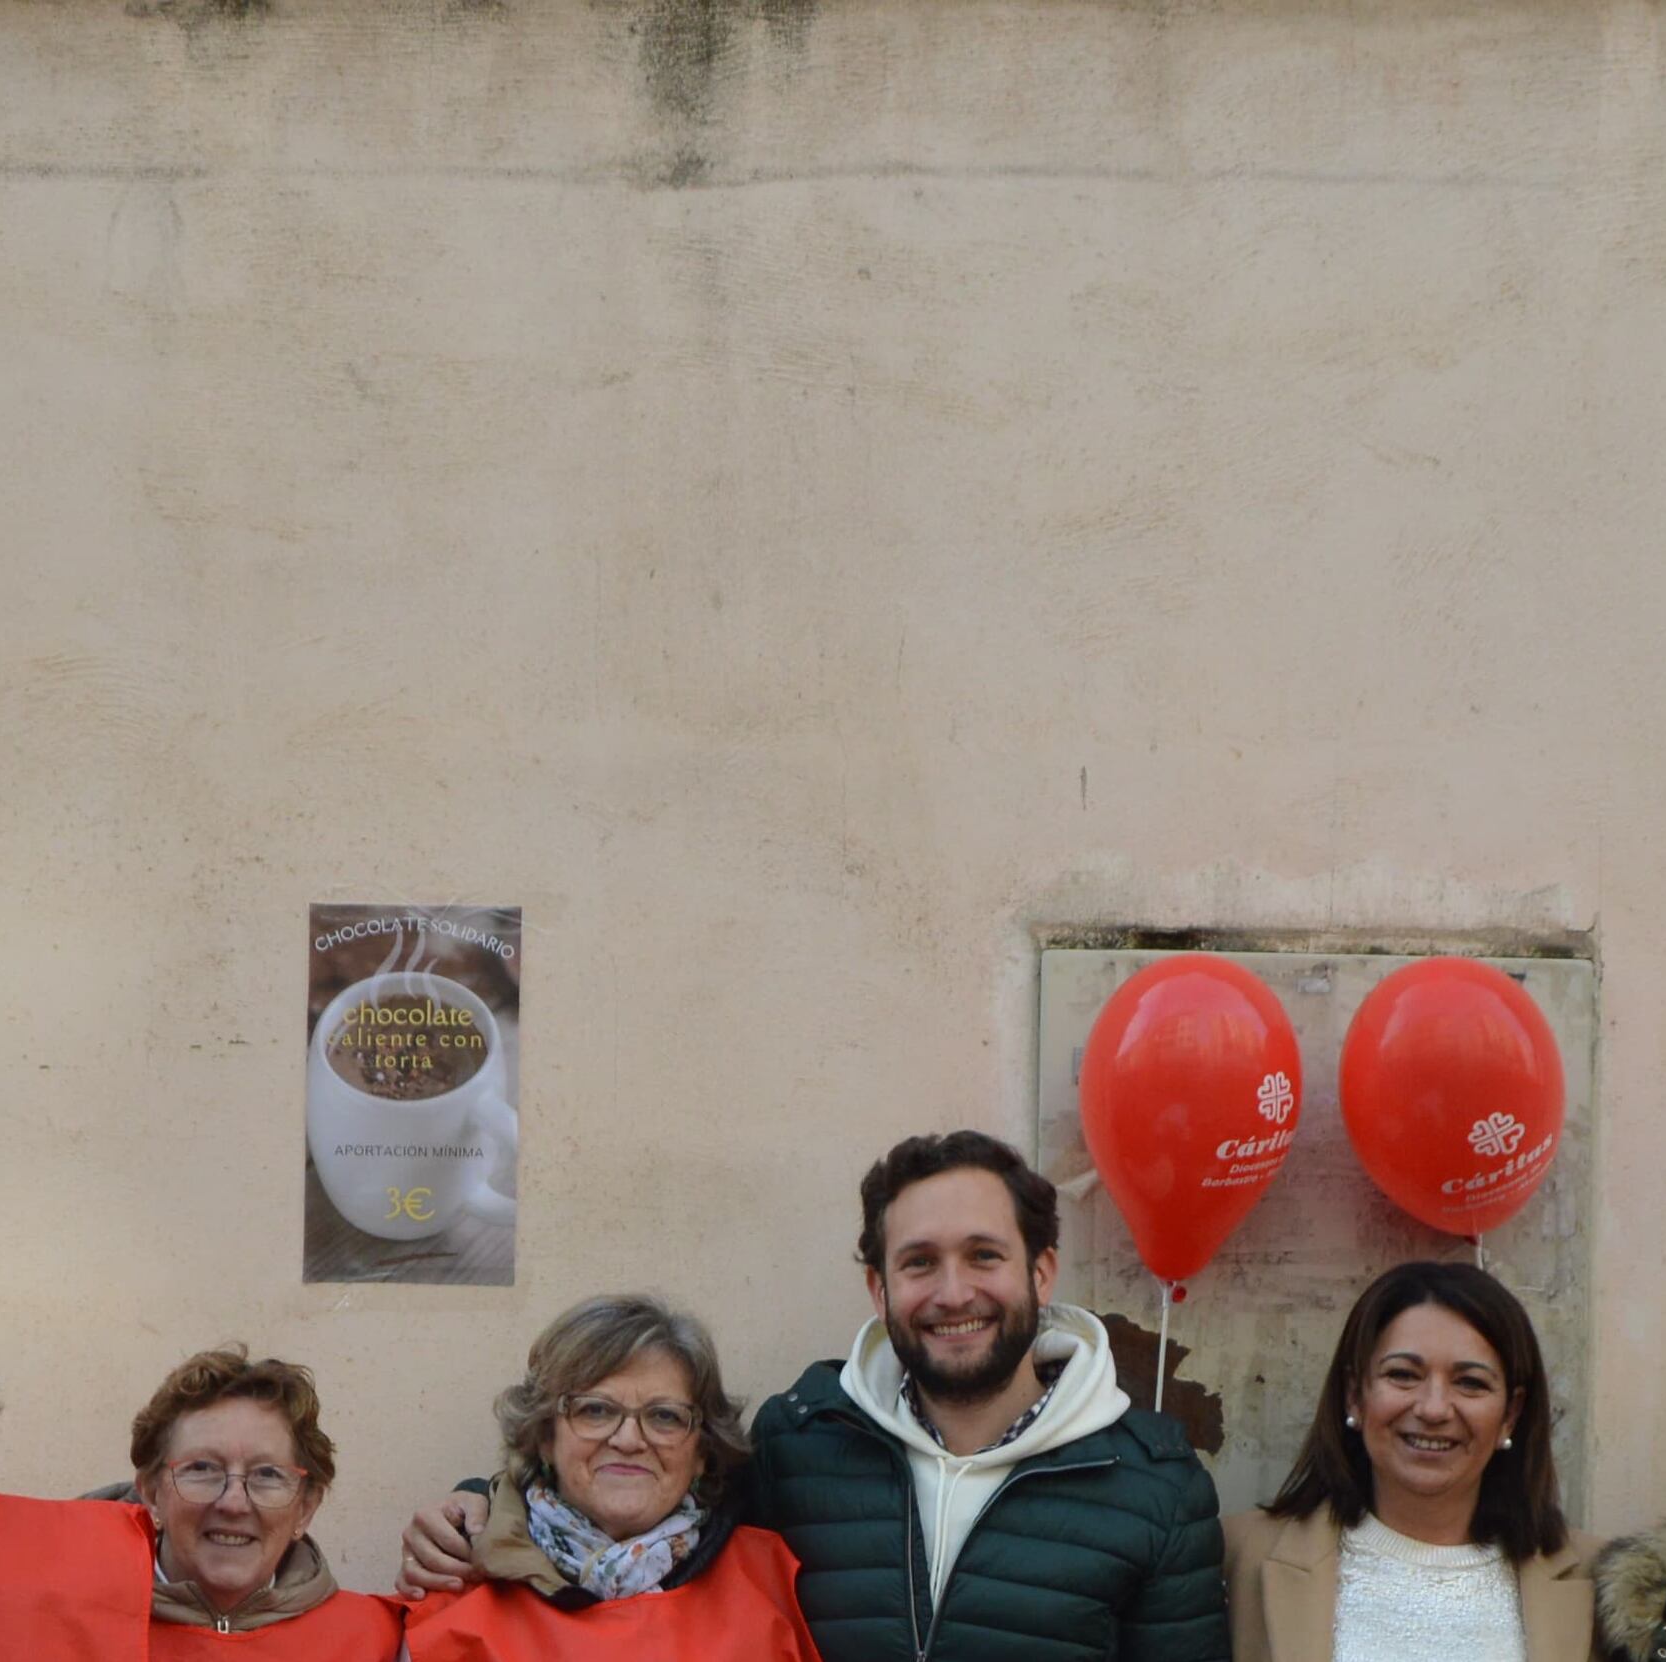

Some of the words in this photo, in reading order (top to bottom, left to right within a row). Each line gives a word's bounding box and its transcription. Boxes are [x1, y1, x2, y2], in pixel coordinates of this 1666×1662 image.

[315, 917, 428, 951] CHOCOLATE
[430, 918, 515, 960] SOLIDARIO
[343, 999, 473, 1026] chocolate
[439, 1033, 483, 1048] con
[374, 1053, 434, 1069] torta
[1440, 1133, 1553, 1195] Cáritas
[384, 1186, 436, 1222] 3€
